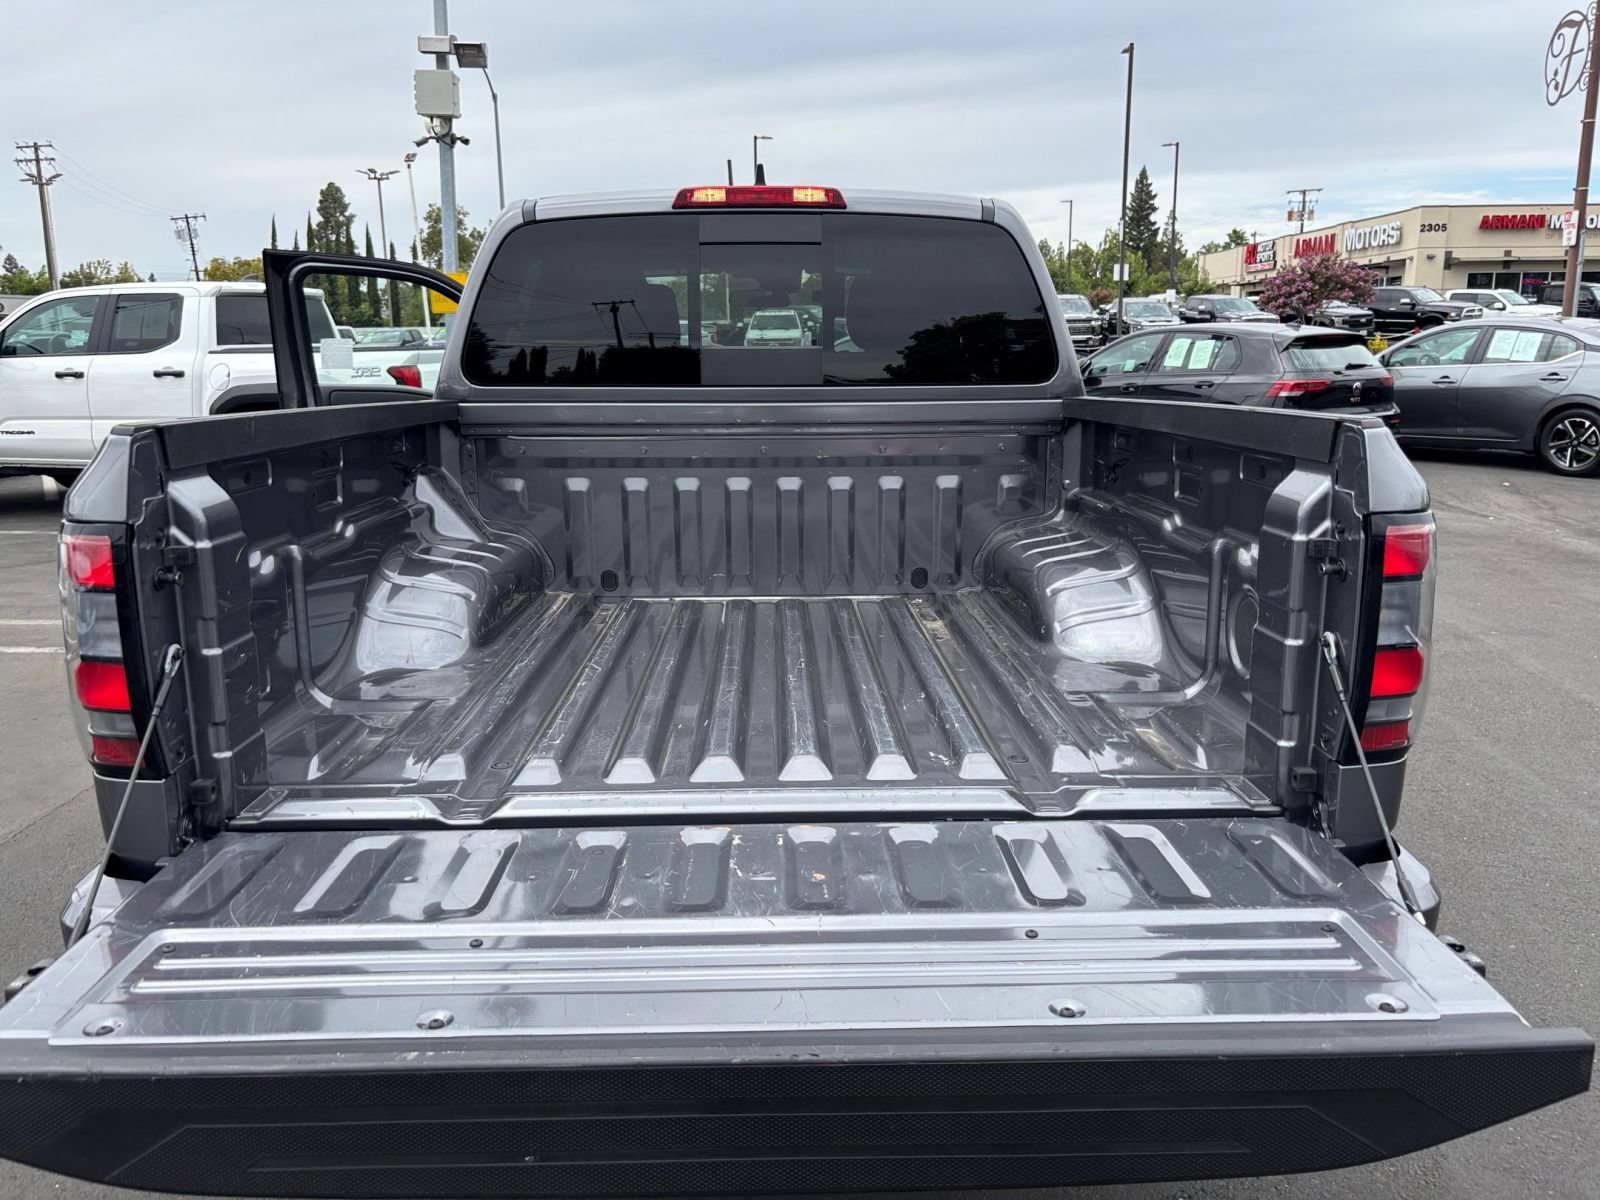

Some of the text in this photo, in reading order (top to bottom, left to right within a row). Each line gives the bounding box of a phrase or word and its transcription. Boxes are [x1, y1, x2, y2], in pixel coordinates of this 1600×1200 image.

[1420, 223, 1448, 233] 2305
[1479, 214, 1547, 230] ARMANI
[1293, 221, 1398, 259] ARMANI MOTORS
